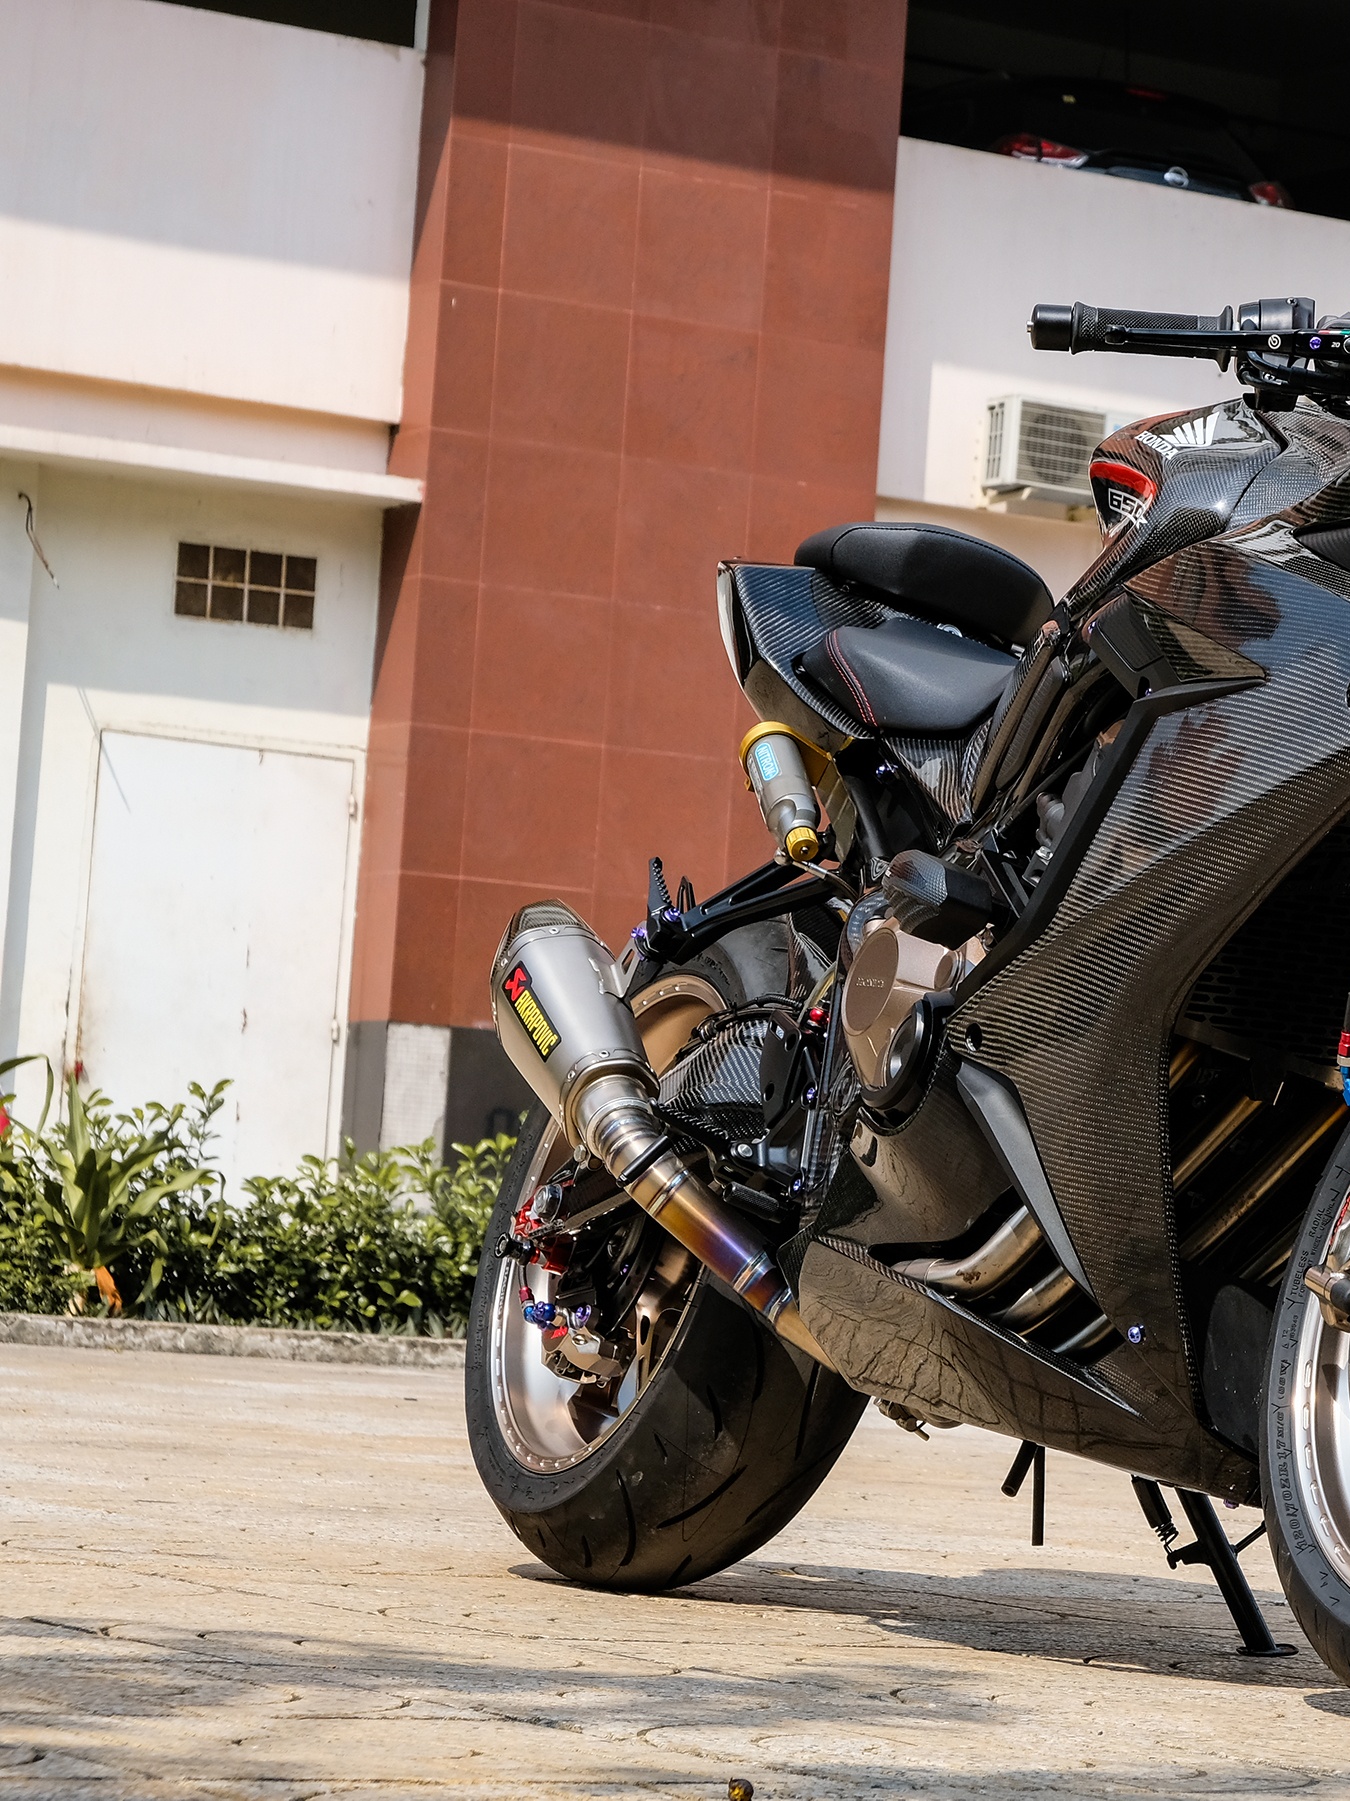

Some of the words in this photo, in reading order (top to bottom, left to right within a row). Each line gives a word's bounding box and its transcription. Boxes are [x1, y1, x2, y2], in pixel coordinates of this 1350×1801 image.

[1134, 430, 1179, 460] HONDA
[757, 745, 776, 776] NITRON
[1290, 1250, 1310, 1296] TUBELESS
[1308, 1208, 1326, 1238] RADIAL
